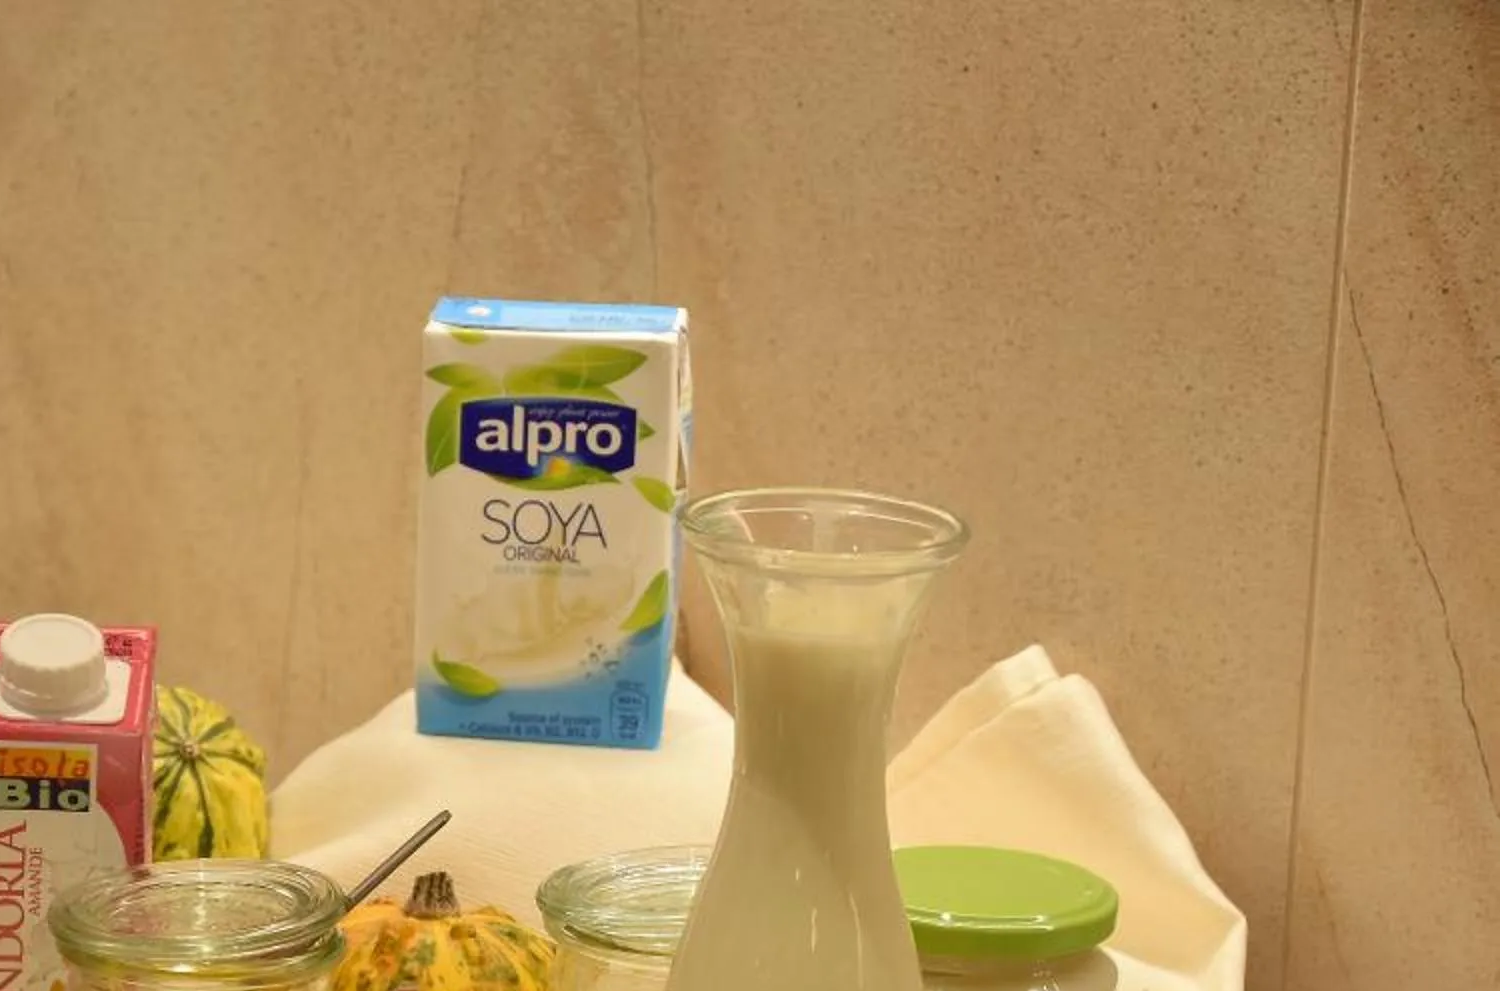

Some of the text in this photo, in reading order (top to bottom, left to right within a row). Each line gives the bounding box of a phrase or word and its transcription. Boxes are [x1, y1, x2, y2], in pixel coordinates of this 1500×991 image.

[476, 405, 622, 466] alpro
[481, 499, 607, 548] SOYA
[503, 545, 581, 563] ORIGINAL
[28, 847, 43, 916] AMANDE
